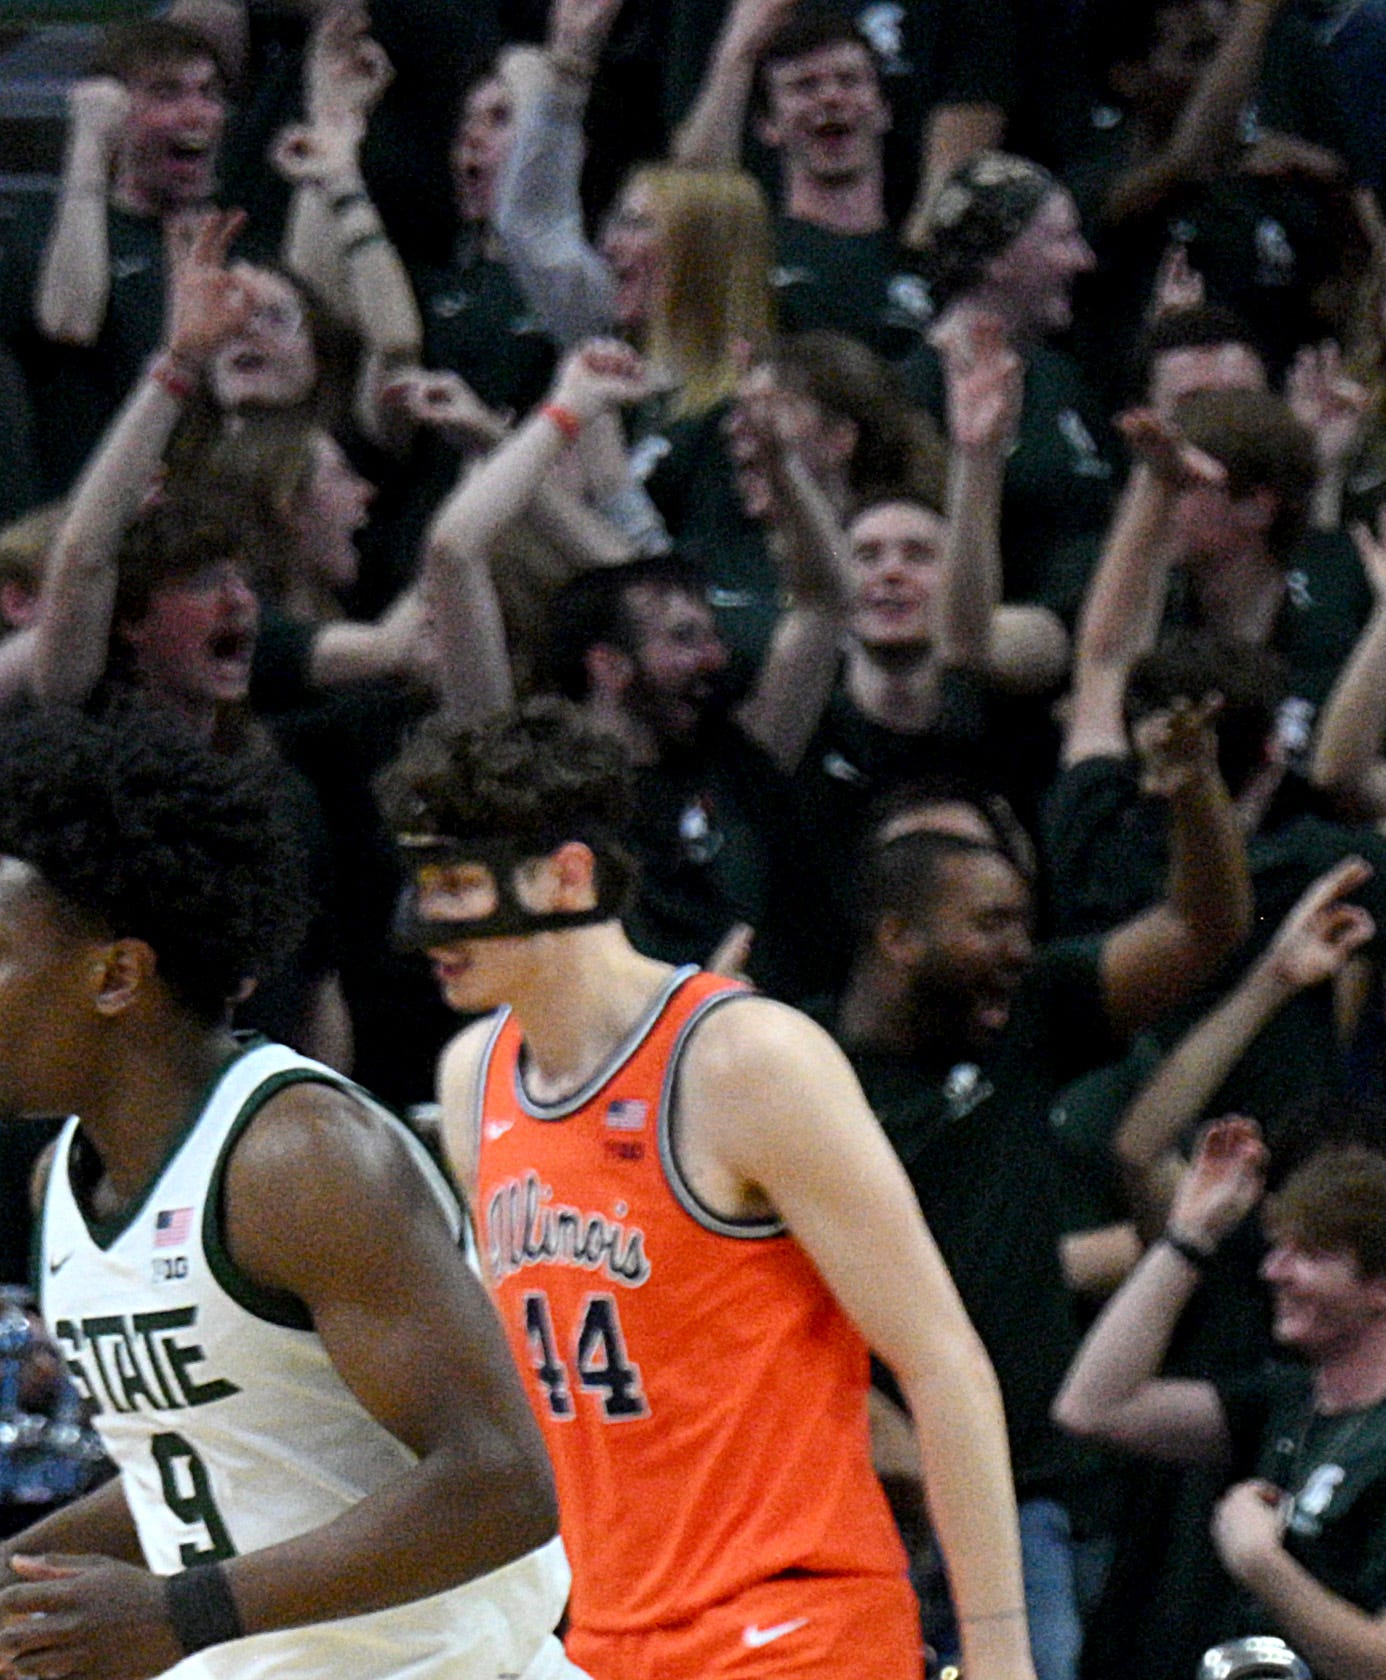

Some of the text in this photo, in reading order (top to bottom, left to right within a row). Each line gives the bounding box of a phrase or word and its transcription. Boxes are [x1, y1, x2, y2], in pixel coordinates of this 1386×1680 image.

[486, 1168, 651, 1289] Illinois
[56, 1306, 243, 1414] STATE
[151, 1432, 238, 1568] 9
